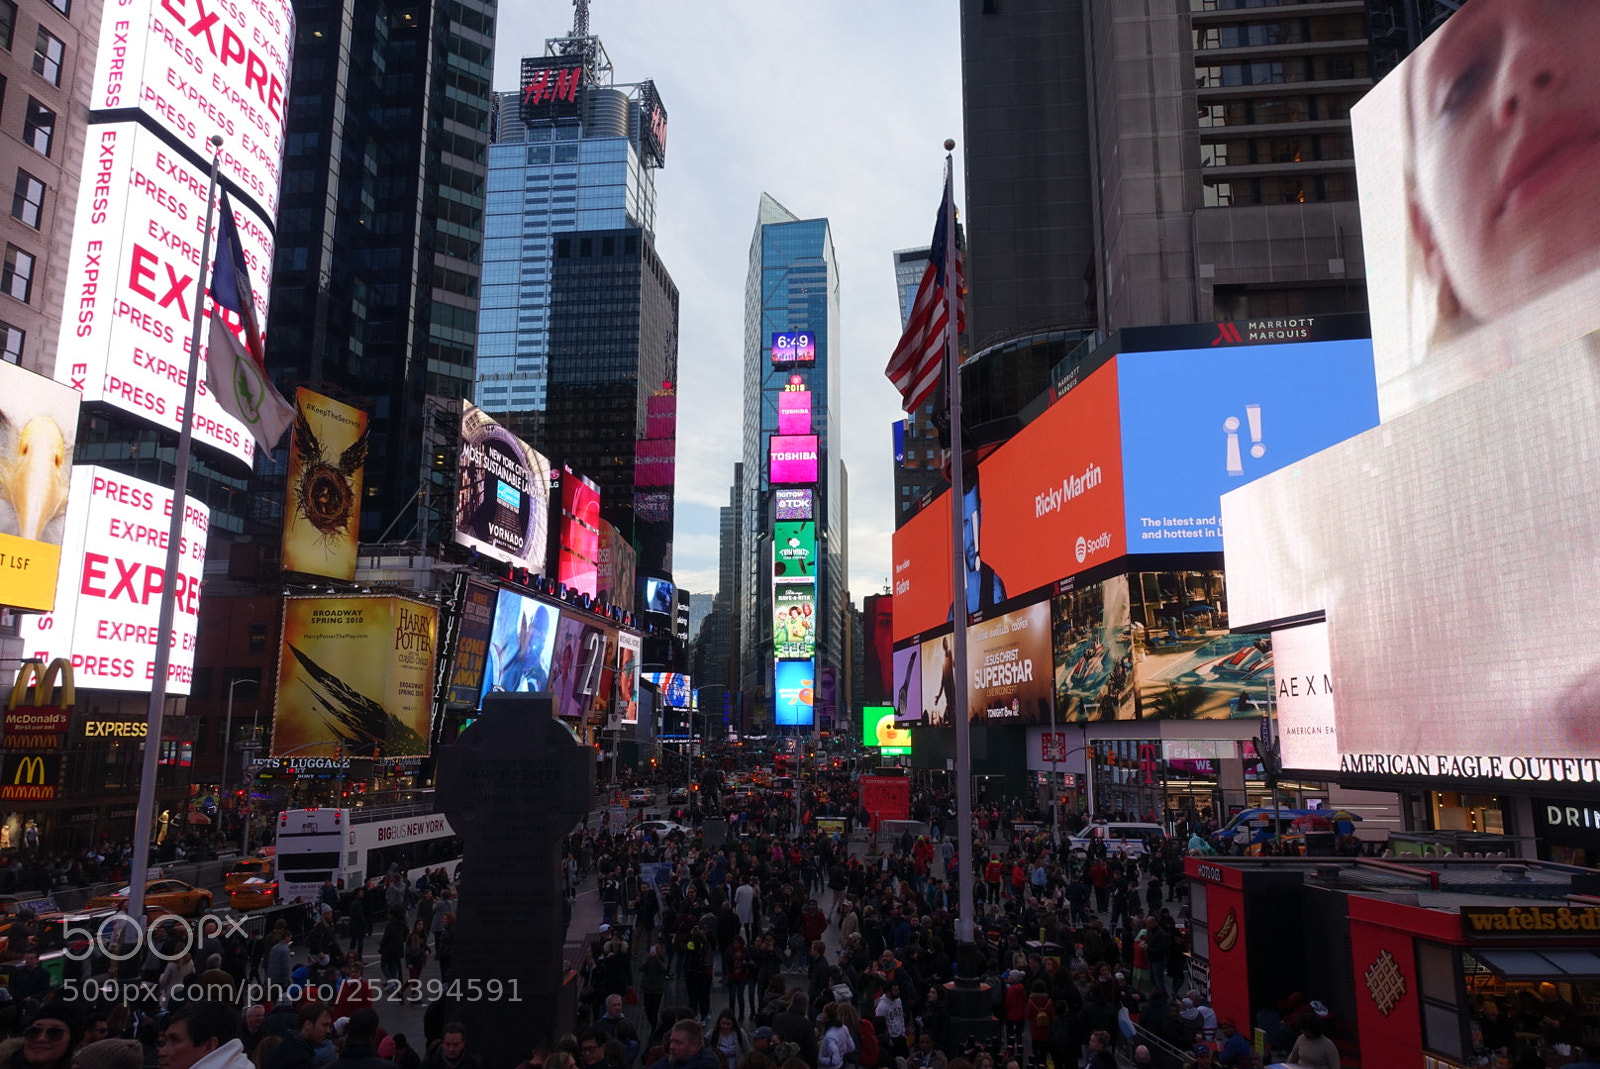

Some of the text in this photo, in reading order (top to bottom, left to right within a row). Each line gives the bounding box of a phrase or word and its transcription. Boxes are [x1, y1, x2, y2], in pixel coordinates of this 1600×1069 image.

[149, 13, 204, 75] PRESS
[105, 20, 130, 107] EXPRESS
[523, 67, 582, 105] H&M
[140, 81, 196, 140] PRESS
[166, 66, 235, 137] EXPRESS
[212, 71, 271, 138] EXPRESS
[91, 130, 117, 225] EXPRESS
[129, 168, 188, 221] PRESS
[76, 239, 103, 338] EXPRESS
[112, 297, 174, 344] PRESS
[1248, 318, 1315, 330] MARRIOTT
[777, 335, 809, 348] 6:49
[1249, 329, 1308, 341] MARQUIS
[133, 346, 207, 397] EXPRES
[104, 373, 166, 415] PRESS
[784, 383, 806, 392] 2018
[175, 404, 240, 448] EPRESS
[306, 403, 362, 428] #KeepTheSecrets
[463, 443, 521, 490] MOST SUSTAINABLE
[489, 446, 502, 462] NEW
[502, 454, 515, 471] YORK
[770, 451, 817, 461] TOSHIBA
[1035, 462, 1102, 519] Ricky Martin
[786, 500, 810, 508] TDK
[1141, 517, 1162, 527] The
[1163, 516, 1194, 527] latest
[1195, 515, 1216, 526] and
[1142, 529, 1162, 539] and
[1164, 527, 1203, 538] hottest
[1205, 527, 1215, 537] in
[109, 518, 187, 556] EXPRES
[488, 522, 524, 548] VORNADO
[1087, 532, 1112, 554] Spotify
[10, 555, 31, 570] LSF
[313, 609, 363, 617] BROADWAY
[400, 608, 433, 637] HARRY
[97, 619, 177, 648] EXPRES
[395, 627, 433, 654] POTTER
[582, 632, 607, 697] 21
[984, 648, 1019, 666] JESUS CHRIST
[453, 669, 480, 687] AWAY
[974, 658, 1033, 690] SUPERSTAR
[1279, 676, 1299, 698] AE
[1306, 674, 1317, 697] X
[5, 713, 67, 724] McDonald's
[85, 721, 149, 737] EXPRESS
[1286, 725, 1337, 736] AMERICAN EA
[1340, 753, 1431, 776] AMERICAN
[1437, 756, 1504, 779] EAGLE
[407, 822, 424, 837] NEW
[425, 819, 445, 834] YORK
